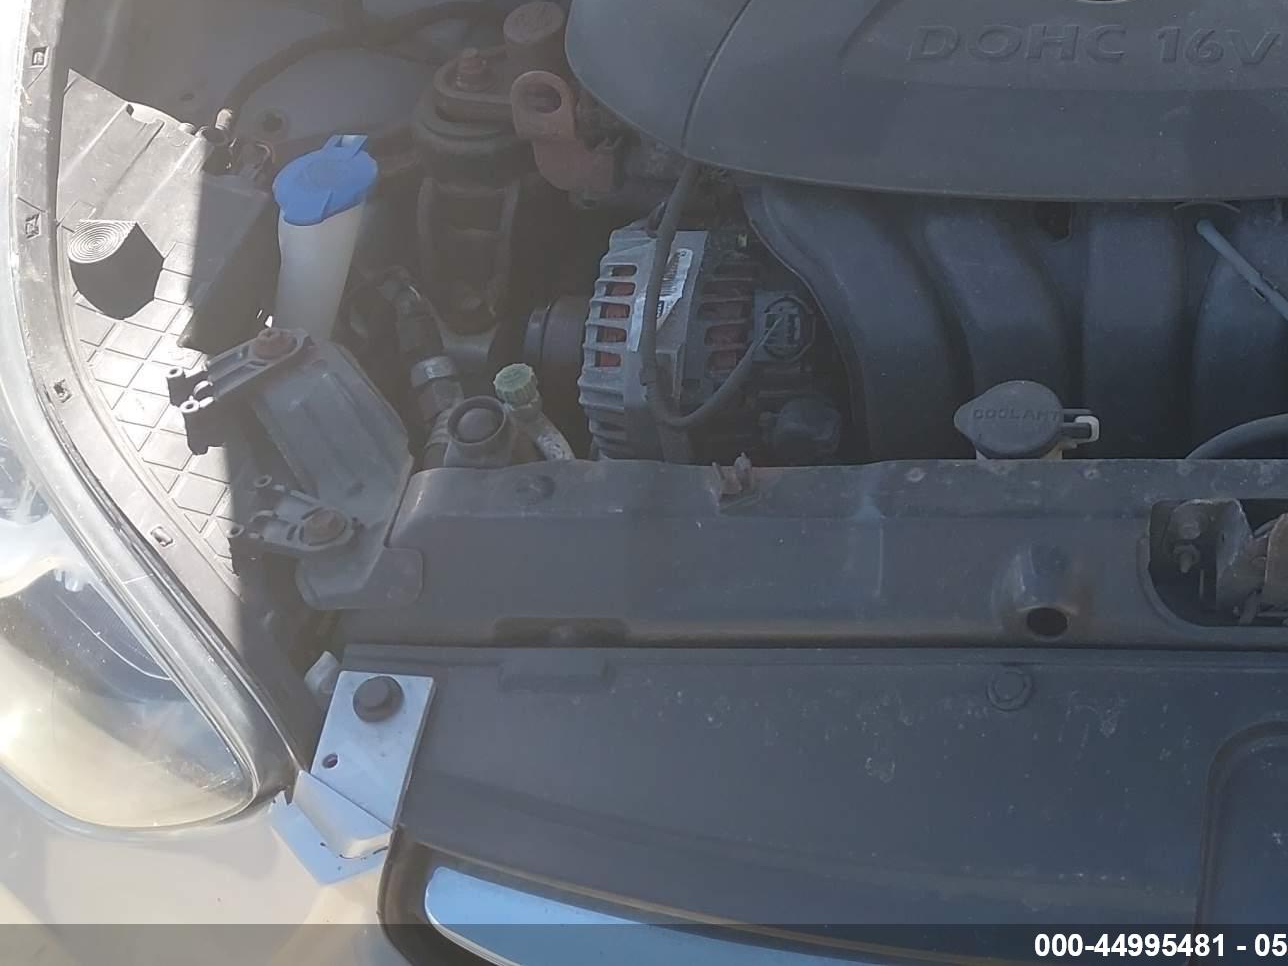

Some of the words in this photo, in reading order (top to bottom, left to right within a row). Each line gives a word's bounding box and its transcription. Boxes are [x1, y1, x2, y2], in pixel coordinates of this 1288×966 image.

[909, 25, 1128, 63] DOHC
[1156, 25, 1282, 66] 16V
[973, 409, 1058, 422] COOLANT
